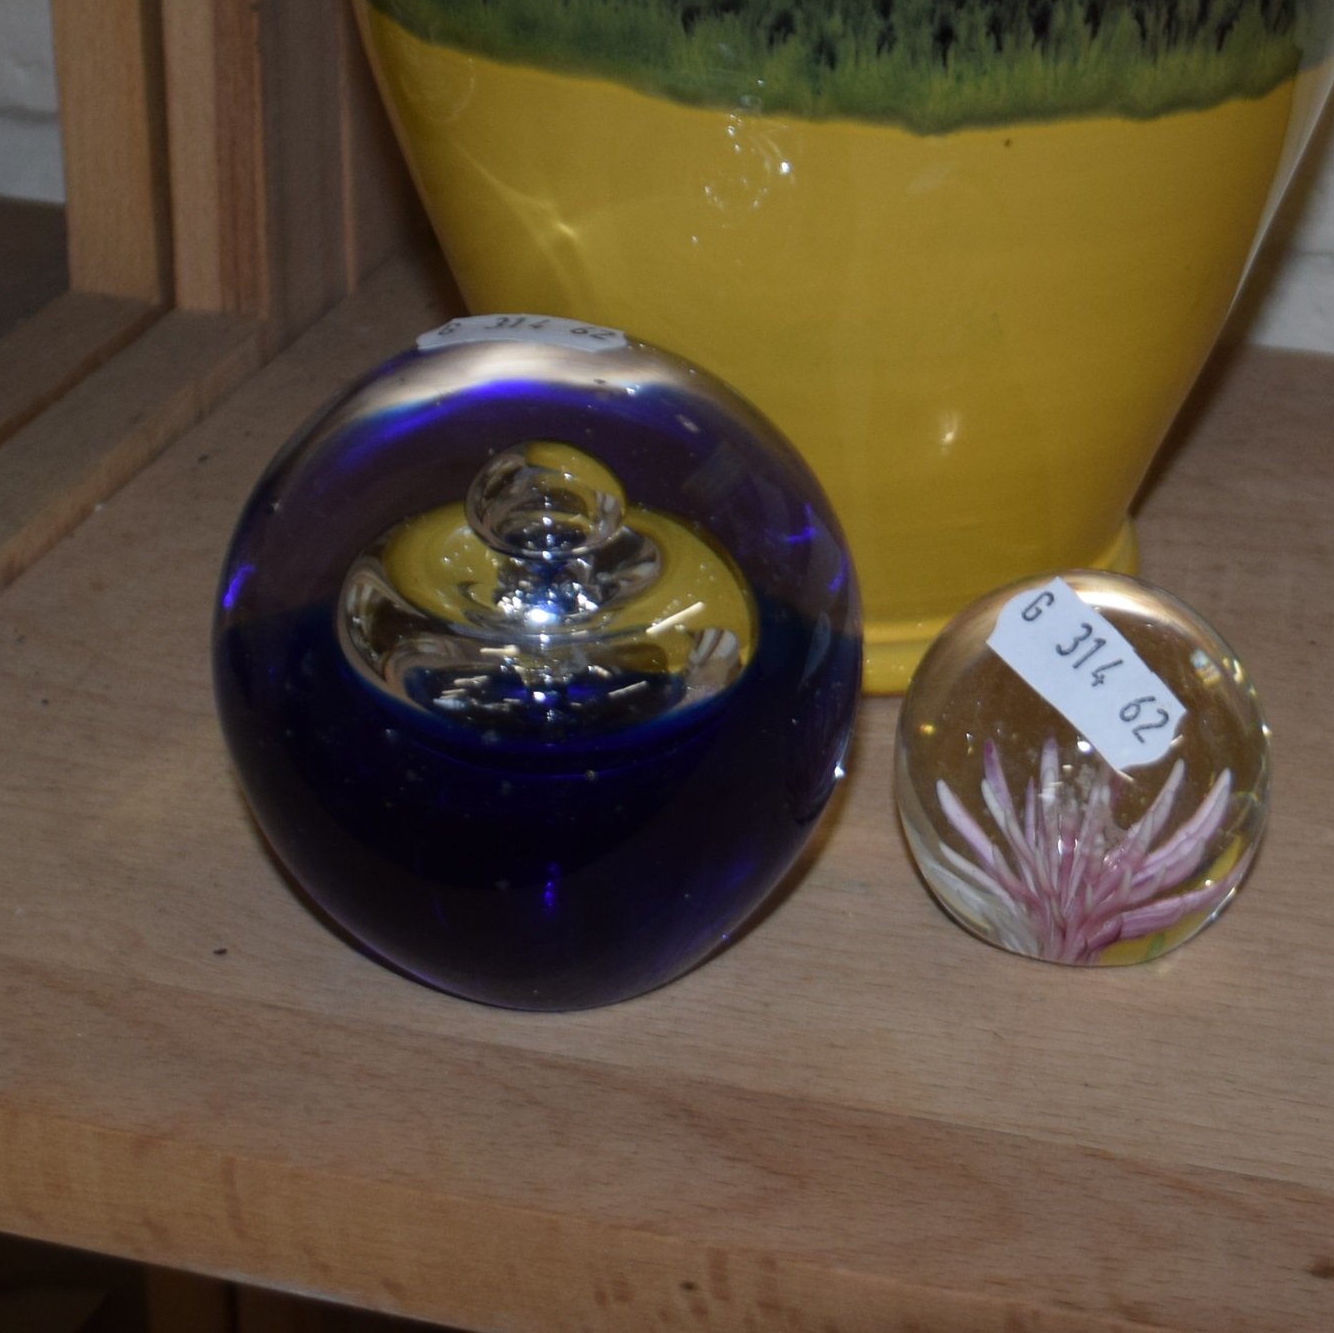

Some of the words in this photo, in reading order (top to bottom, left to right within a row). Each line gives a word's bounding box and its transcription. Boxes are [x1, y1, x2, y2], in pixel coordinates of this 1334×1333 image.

[484, 317, 550, 330] 314
[570, 326, 616, 340] 62
[1021, 591, 1054, 622] G
[1056, 623, 1122, 686] 314
[1119, 696, 1169, 743] 62
